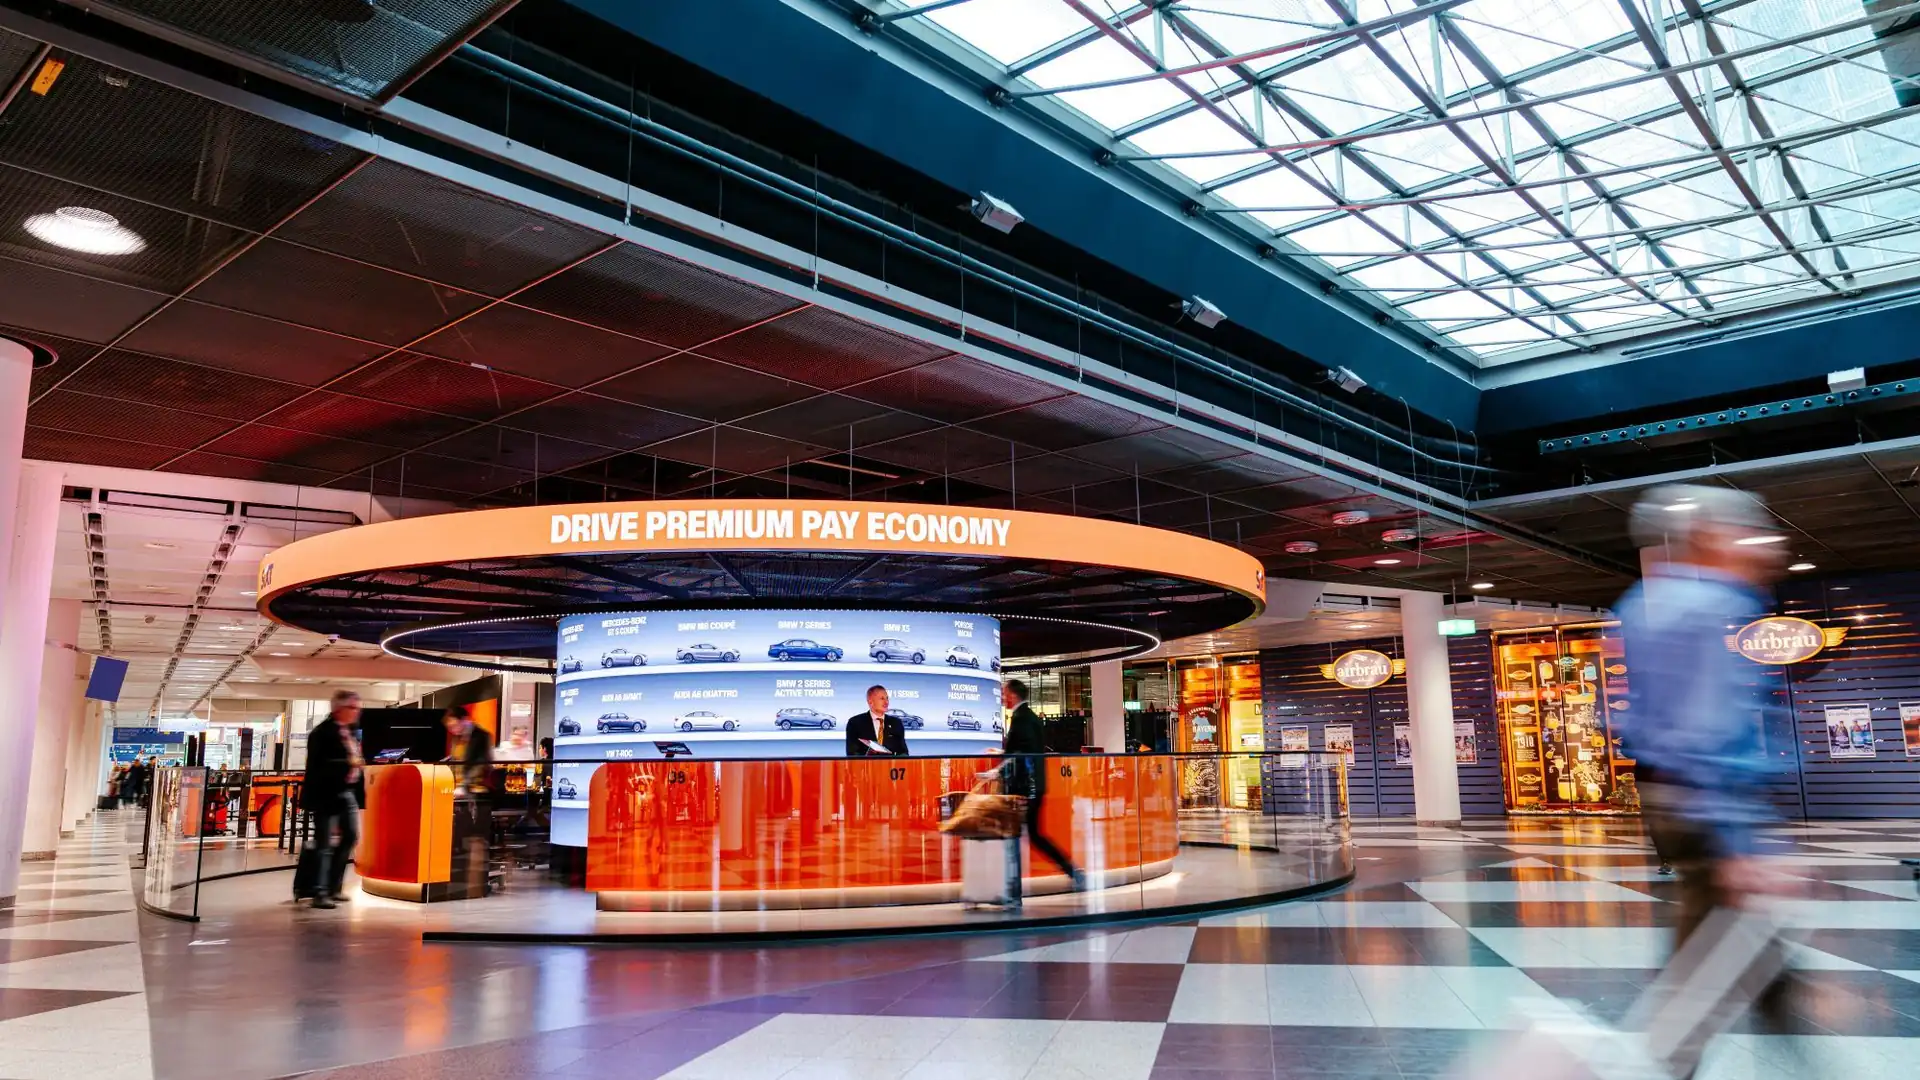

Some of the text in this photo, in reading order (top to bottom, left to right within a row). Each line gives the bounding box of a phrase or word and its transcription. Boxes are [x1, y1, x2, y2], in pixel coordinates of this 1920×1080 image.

[550, 510, 1011, 546] DRIVE PREMIUM PAY ECONOMY
[601, 616, 647, 628] MERCEDES-BENZ
[678, 622, 696, 631] BMW
[710, 620, 736, 630] COUPÉ
[778, 620, 832, 629] BMW 7 SERIES
[884, 623, 900, 632] BMW
[776, 680, 831, 688] BMW 2 SERIES
[673, 690, 690, 699] AUDI
[703, 689, 738, 698] QUATTRO
[774, 689, 834, 697] ACTIVE TOURER
[898, 690, 919, 698] SERIES
[616, 749, 633, 757] T-ROC
[890, 767, 906, 780] 07
[1060, 765, 1072, 777] 06
